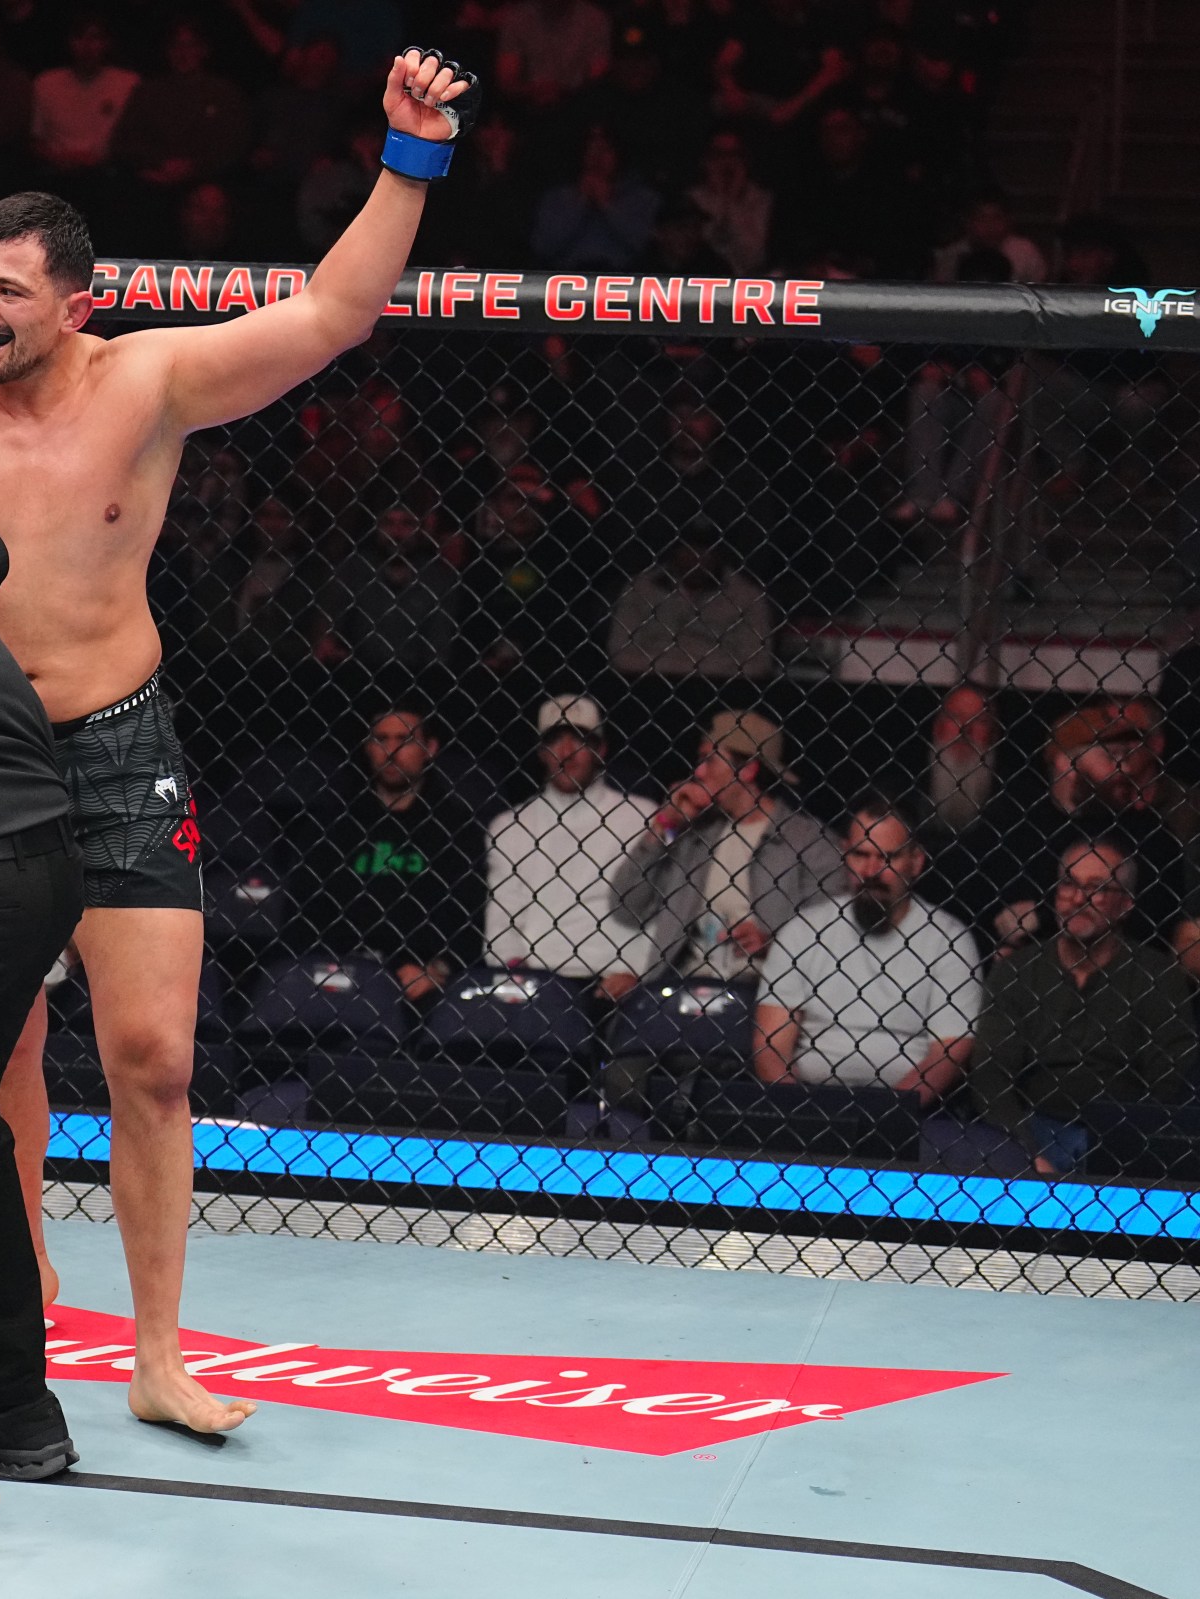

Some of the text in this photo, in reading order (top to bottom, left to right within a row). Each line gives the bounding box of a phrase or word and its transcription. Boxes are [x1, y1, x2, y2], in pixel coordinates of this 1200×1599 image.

[92, 263, 824, 326] CANAD IFE CENTRE
[1104, 298, 1195, 316] IGNITE
